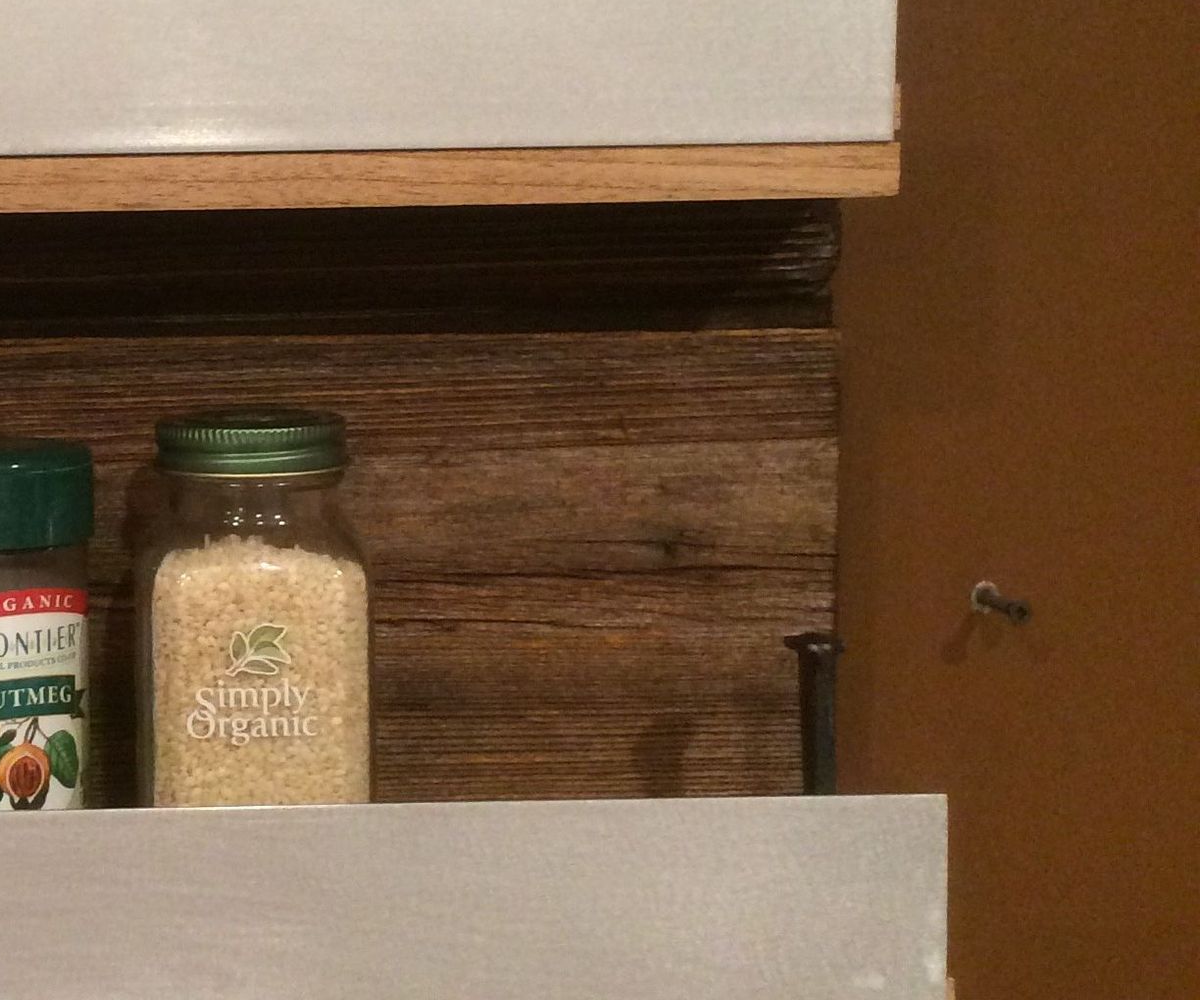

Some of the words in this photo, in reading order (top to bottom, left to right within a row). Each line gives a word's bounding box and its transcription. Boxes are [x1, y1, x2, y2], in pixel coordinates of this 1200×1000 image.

[7, 657, 56, 670] PRODUCTS
[195, 678, 312, 720] Simply
[186, 709, 319, 746] Organic
